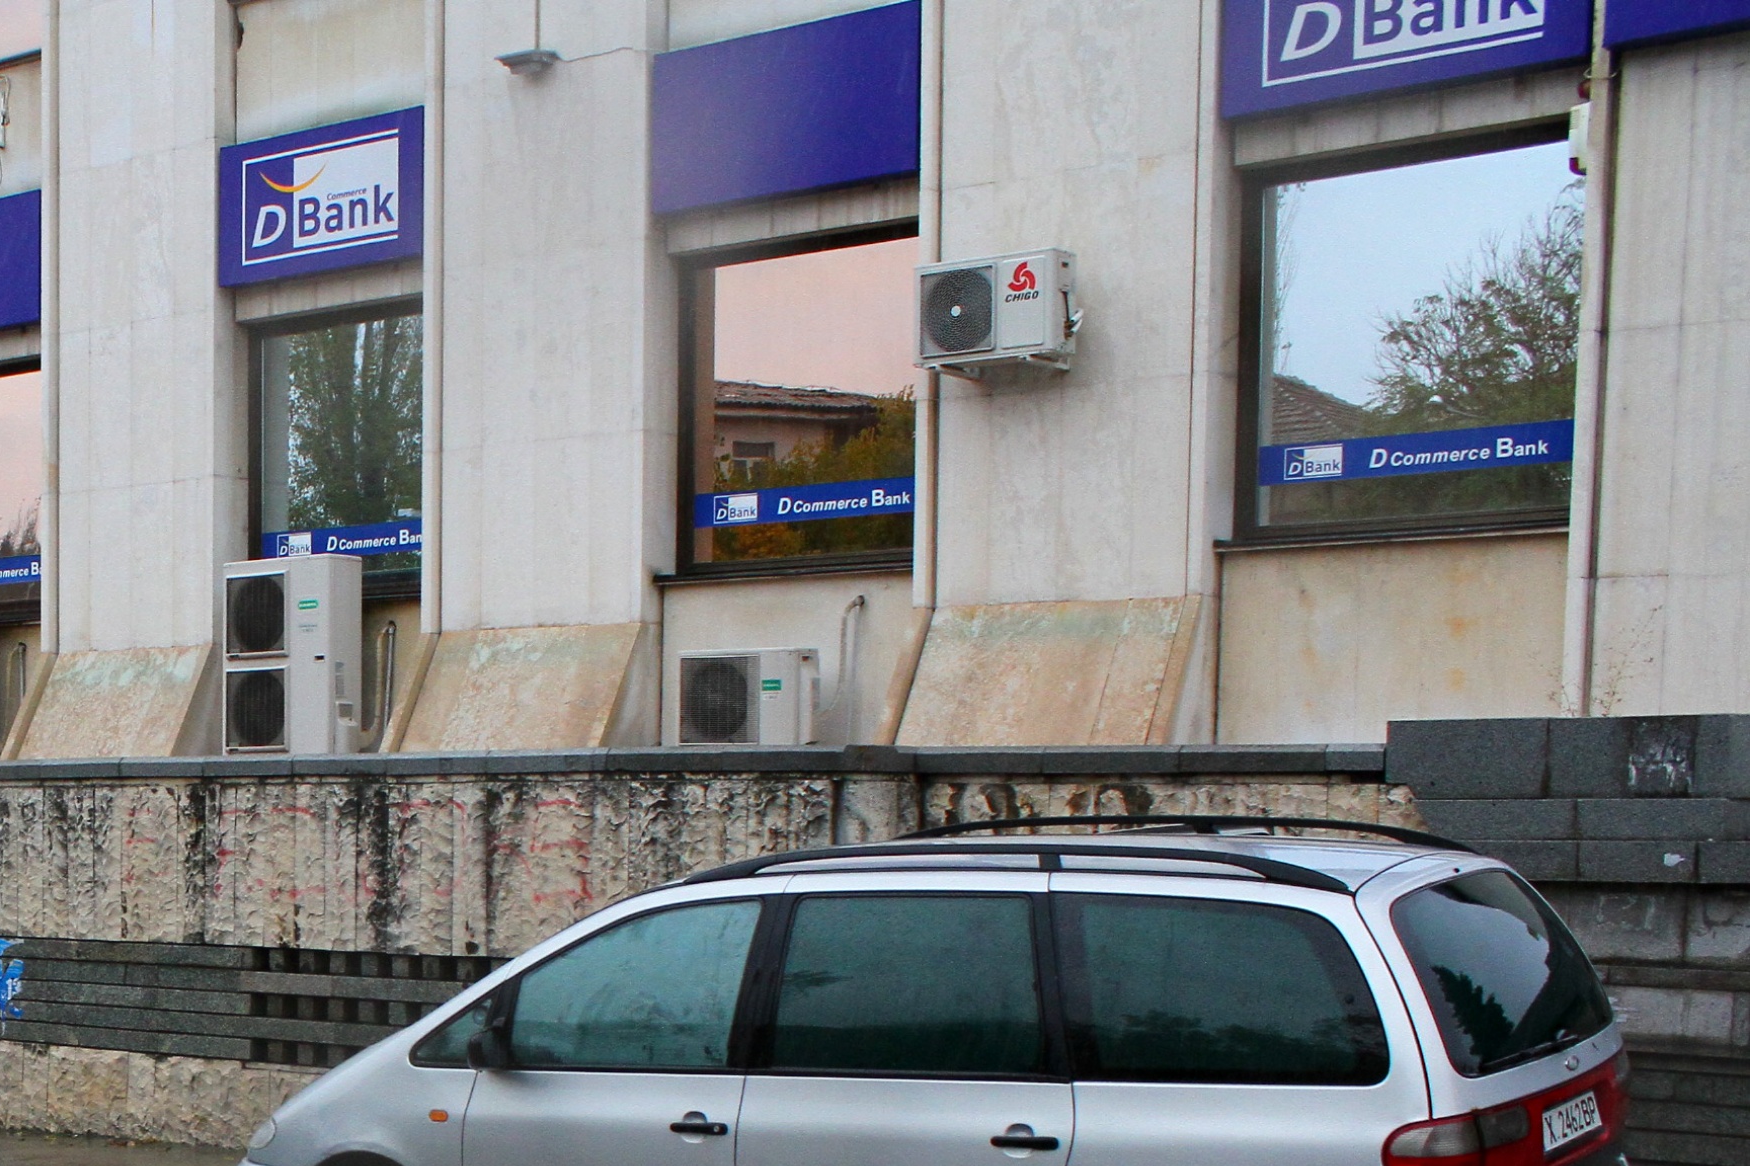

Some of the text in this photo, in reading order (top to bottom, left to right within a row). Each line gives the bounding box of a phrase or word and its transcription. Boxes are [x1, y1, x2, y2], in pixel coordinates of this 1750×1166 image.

[327, 187, 367, 201] Commerce
[252, 184, 394, 248] D Bank
[1005, 290, 1039, 303] CHIGO
[1369, 437, 1549, 469] D Commerce Bank
[1304, 459, 1341, 474] Bank
[777, 489, 910, 515] D Commerce Bank
[327, 535, 338, 551] D
[339, 537, 397, 550] Commerce
